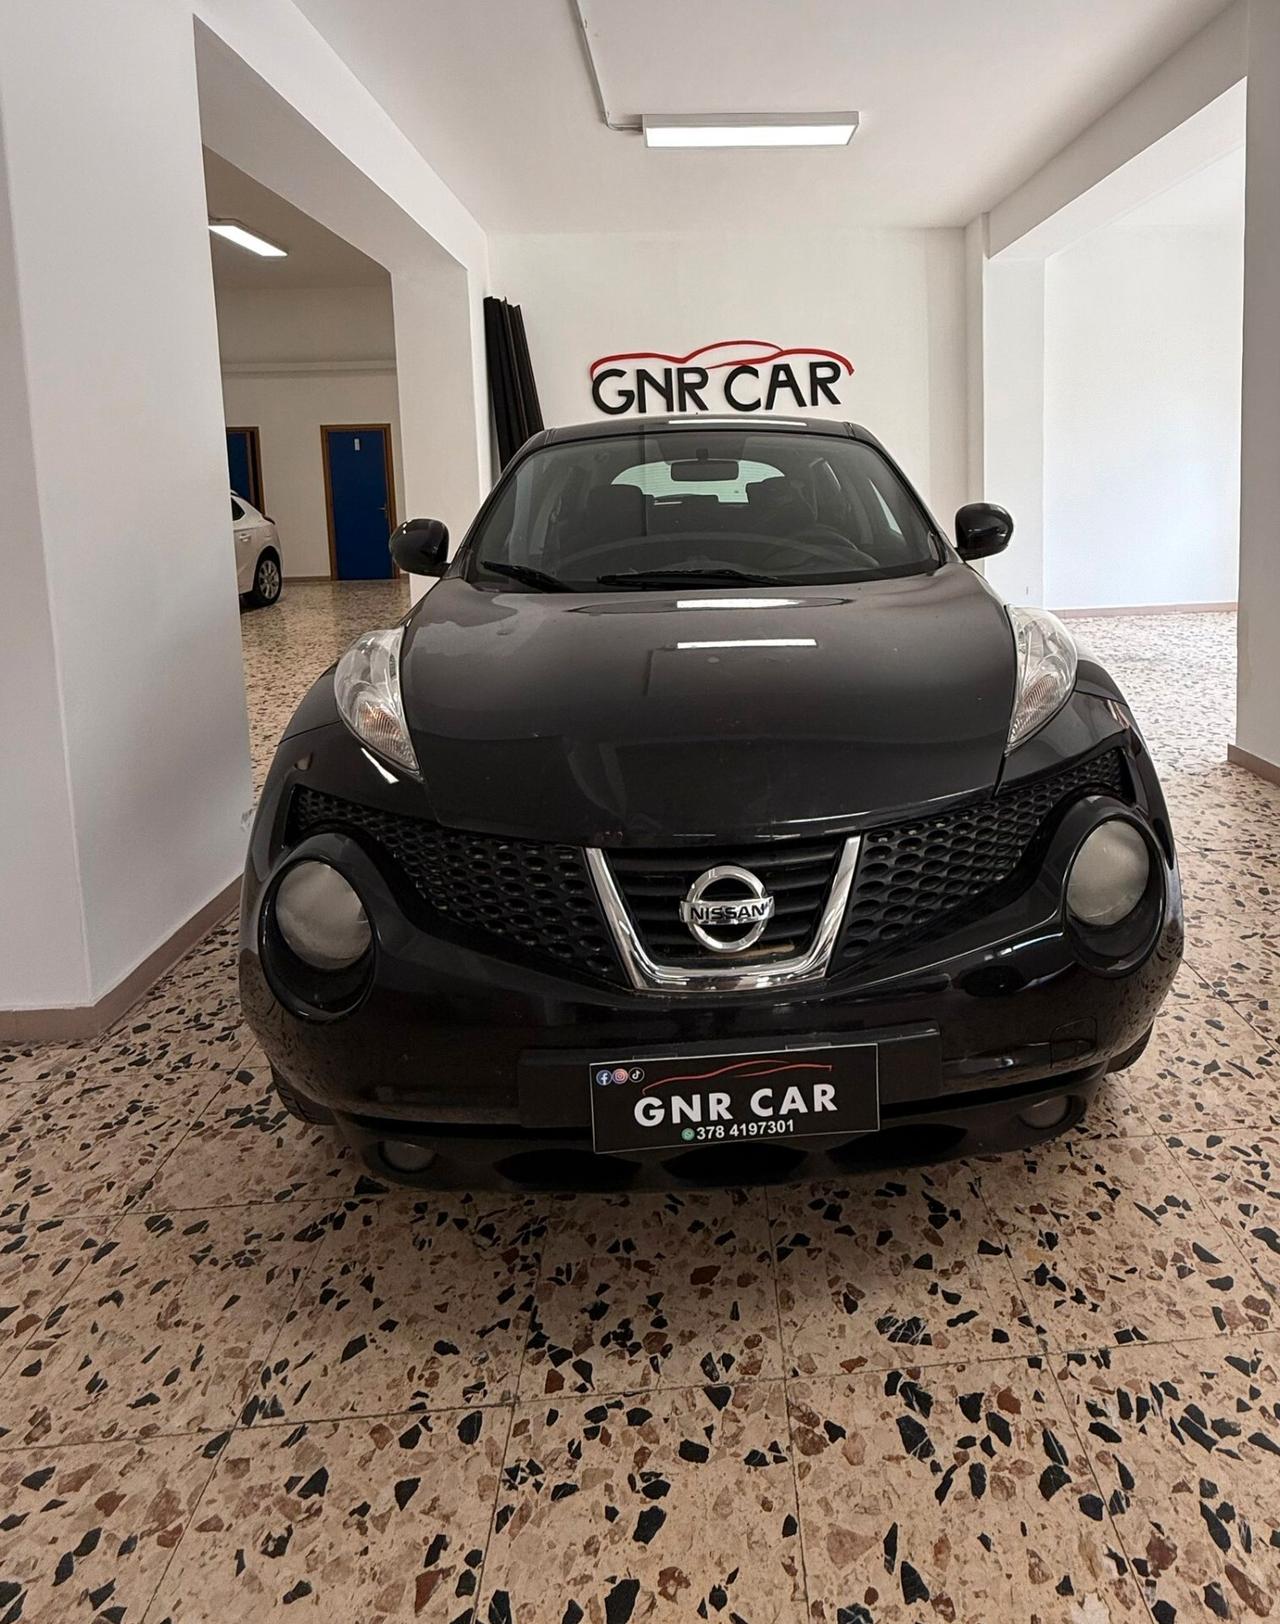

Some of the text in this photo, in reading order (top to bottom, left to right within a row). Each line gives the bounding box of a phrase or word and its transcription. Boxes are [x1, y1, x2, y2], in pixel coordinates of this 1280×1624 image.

[592, 361, 841, 415] GNR CAR
[690, 903, 765, 921] NISSAN
[634, 1083, 838, 1127] GNR CAR
[696, 1119, 795, 1140] 378 4197301
